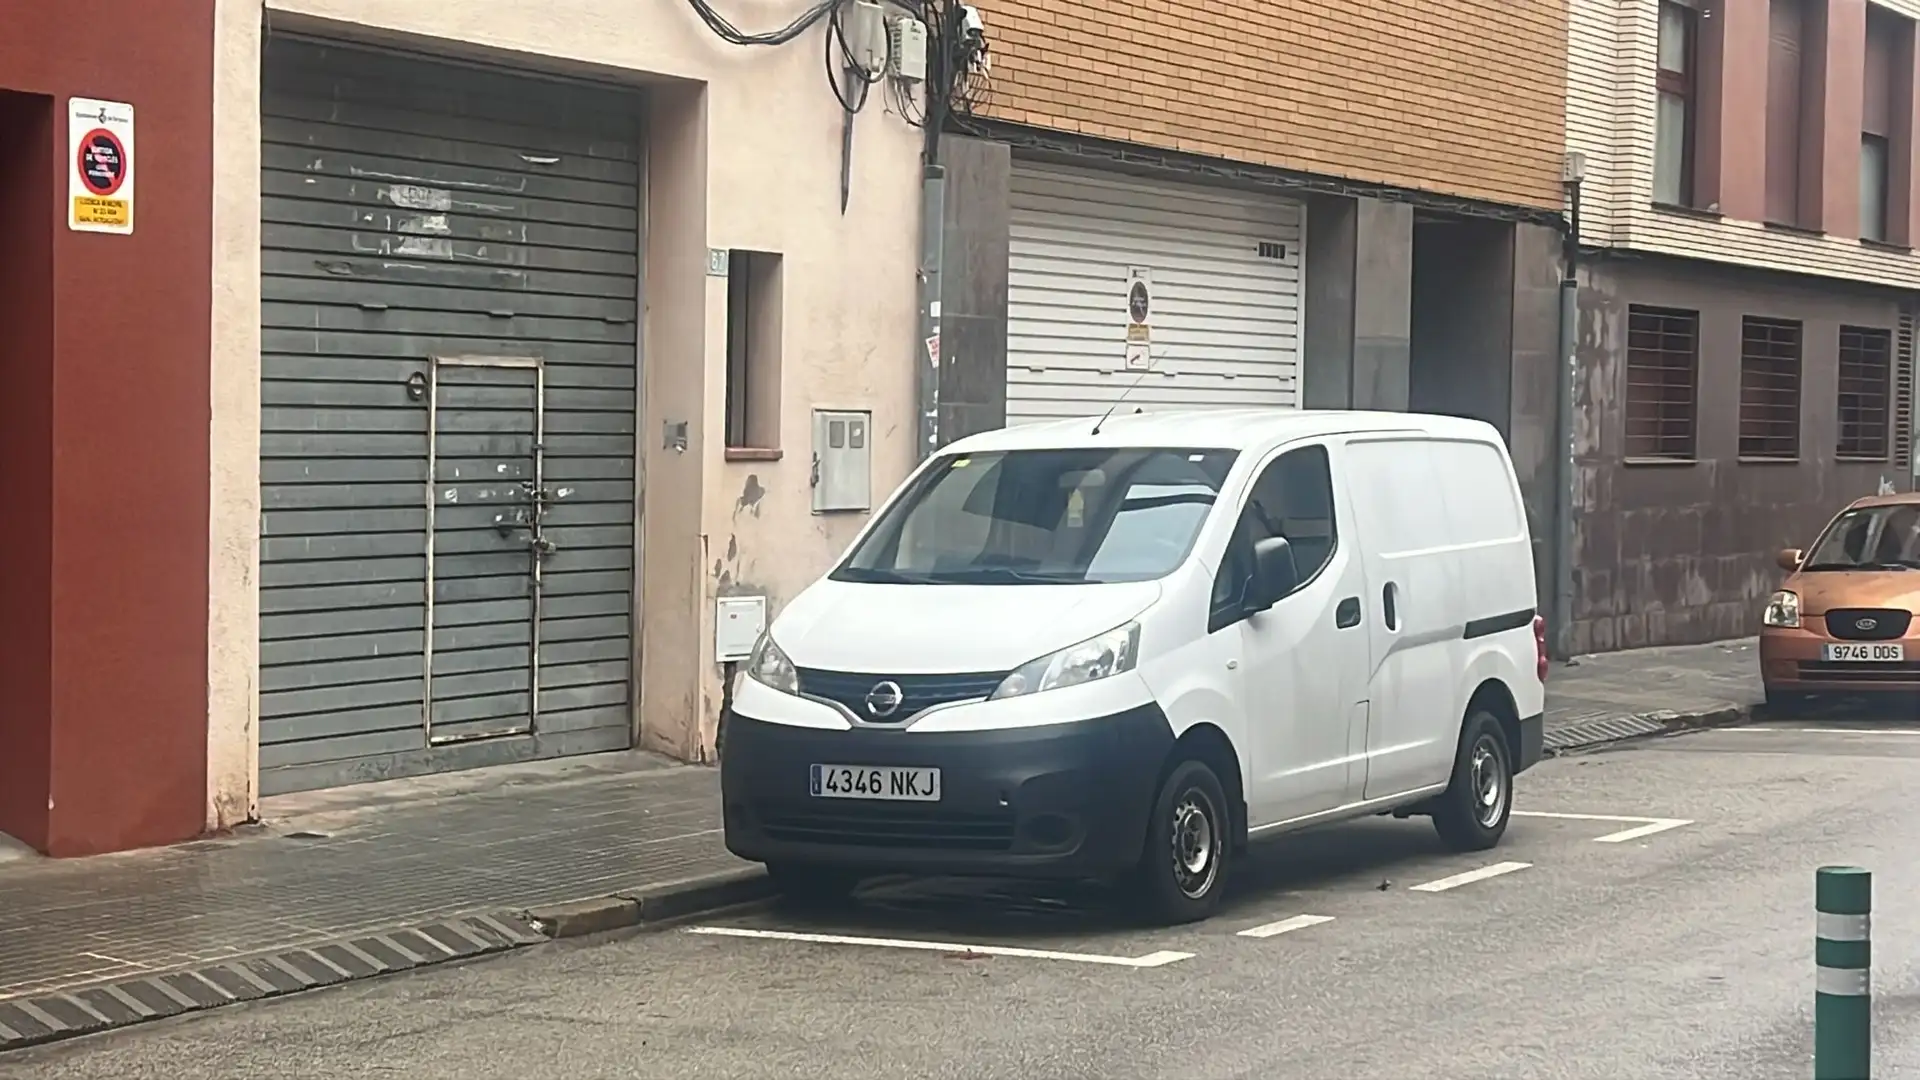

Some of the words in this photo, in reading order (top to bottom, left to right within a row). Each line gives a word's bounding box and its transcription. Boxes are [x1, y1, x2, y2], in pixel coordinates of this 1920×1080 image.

[1833, 645, 1869, 659] 9746
[1873, 645, 1899, 659] DDS
[826, 769, 882, 794] 4346
[890, 771, 934, 796] NKJ
